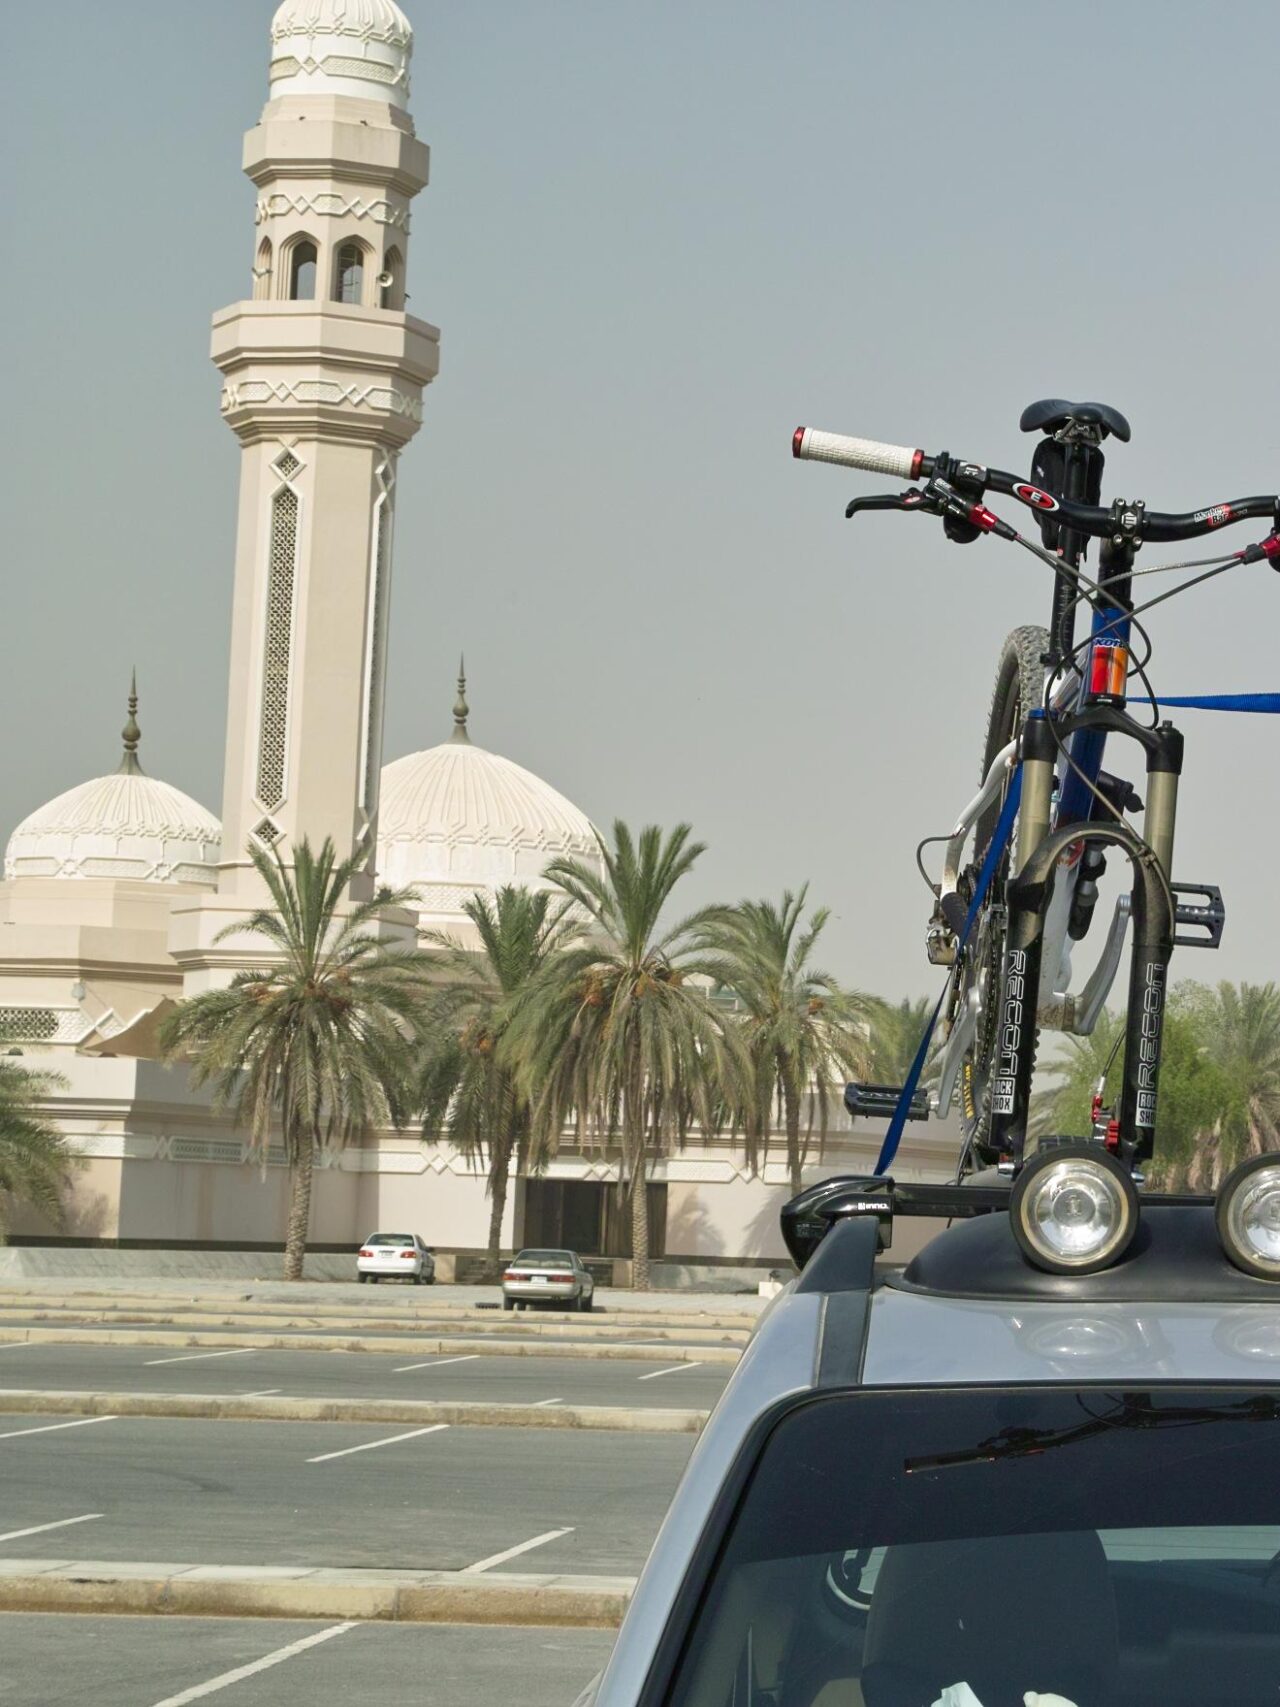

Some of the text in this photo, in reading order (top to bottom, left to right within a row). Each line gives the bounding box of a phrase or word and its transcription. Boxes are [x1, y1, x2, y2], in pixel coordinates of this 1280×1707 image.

[1000, 949, 1026, 1076] RECON
[1137, 962, 1164, 1088] RECON
[992, 1097, 1011, 1111] HOX
[994, 1080, 1012, 1094] OCK
